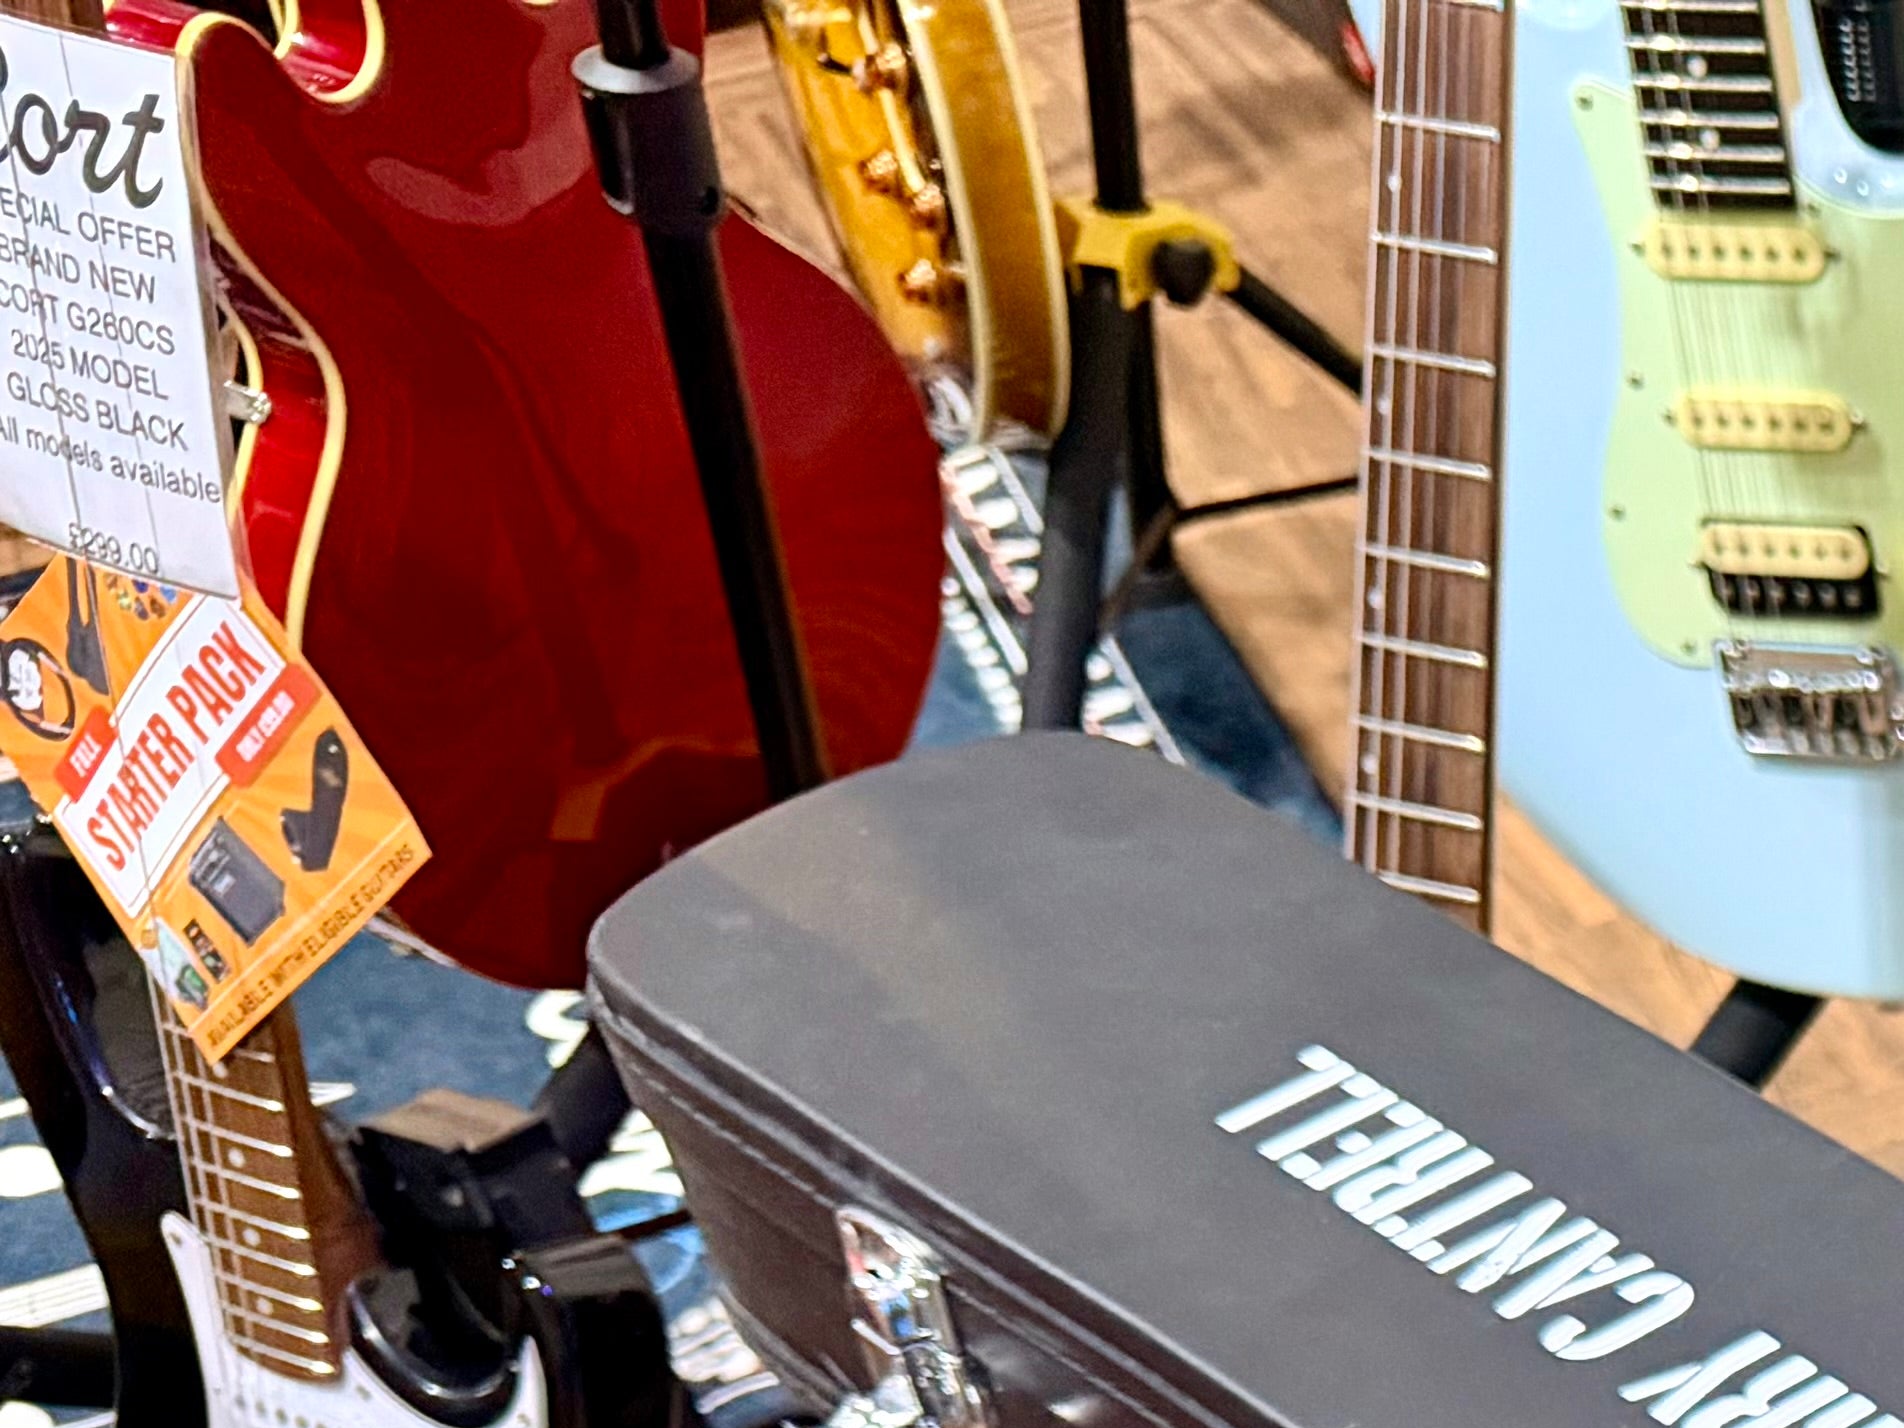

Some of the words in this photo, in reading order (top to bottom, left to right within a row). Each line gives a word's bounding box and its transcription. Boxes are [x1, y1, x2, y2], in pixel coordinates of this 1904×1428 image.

[0, 46, 165, 208] ort
[0, 186, 71, 236] ECIAL
[77, 211, 176, 263] OFFER
[0, 232, 80, 284] BRAND
[88, 260, 155, 304] NEW
[11, 329, 65, 370] 2025
[70, 346, 169, 400] MODEL
[67, 301, 175, 356] G260CS
[7, 371, 89, 423] GLOSS
[96, 400, 188, 452] BLACK
[26, 428, 103, 472] models
[109, 455, 221, 503] available
[87, 713, 195, 871] STARTER
[166, 620, 266, 744] PACK
[1214, 1044, 1695, 1361] CANTRELL
